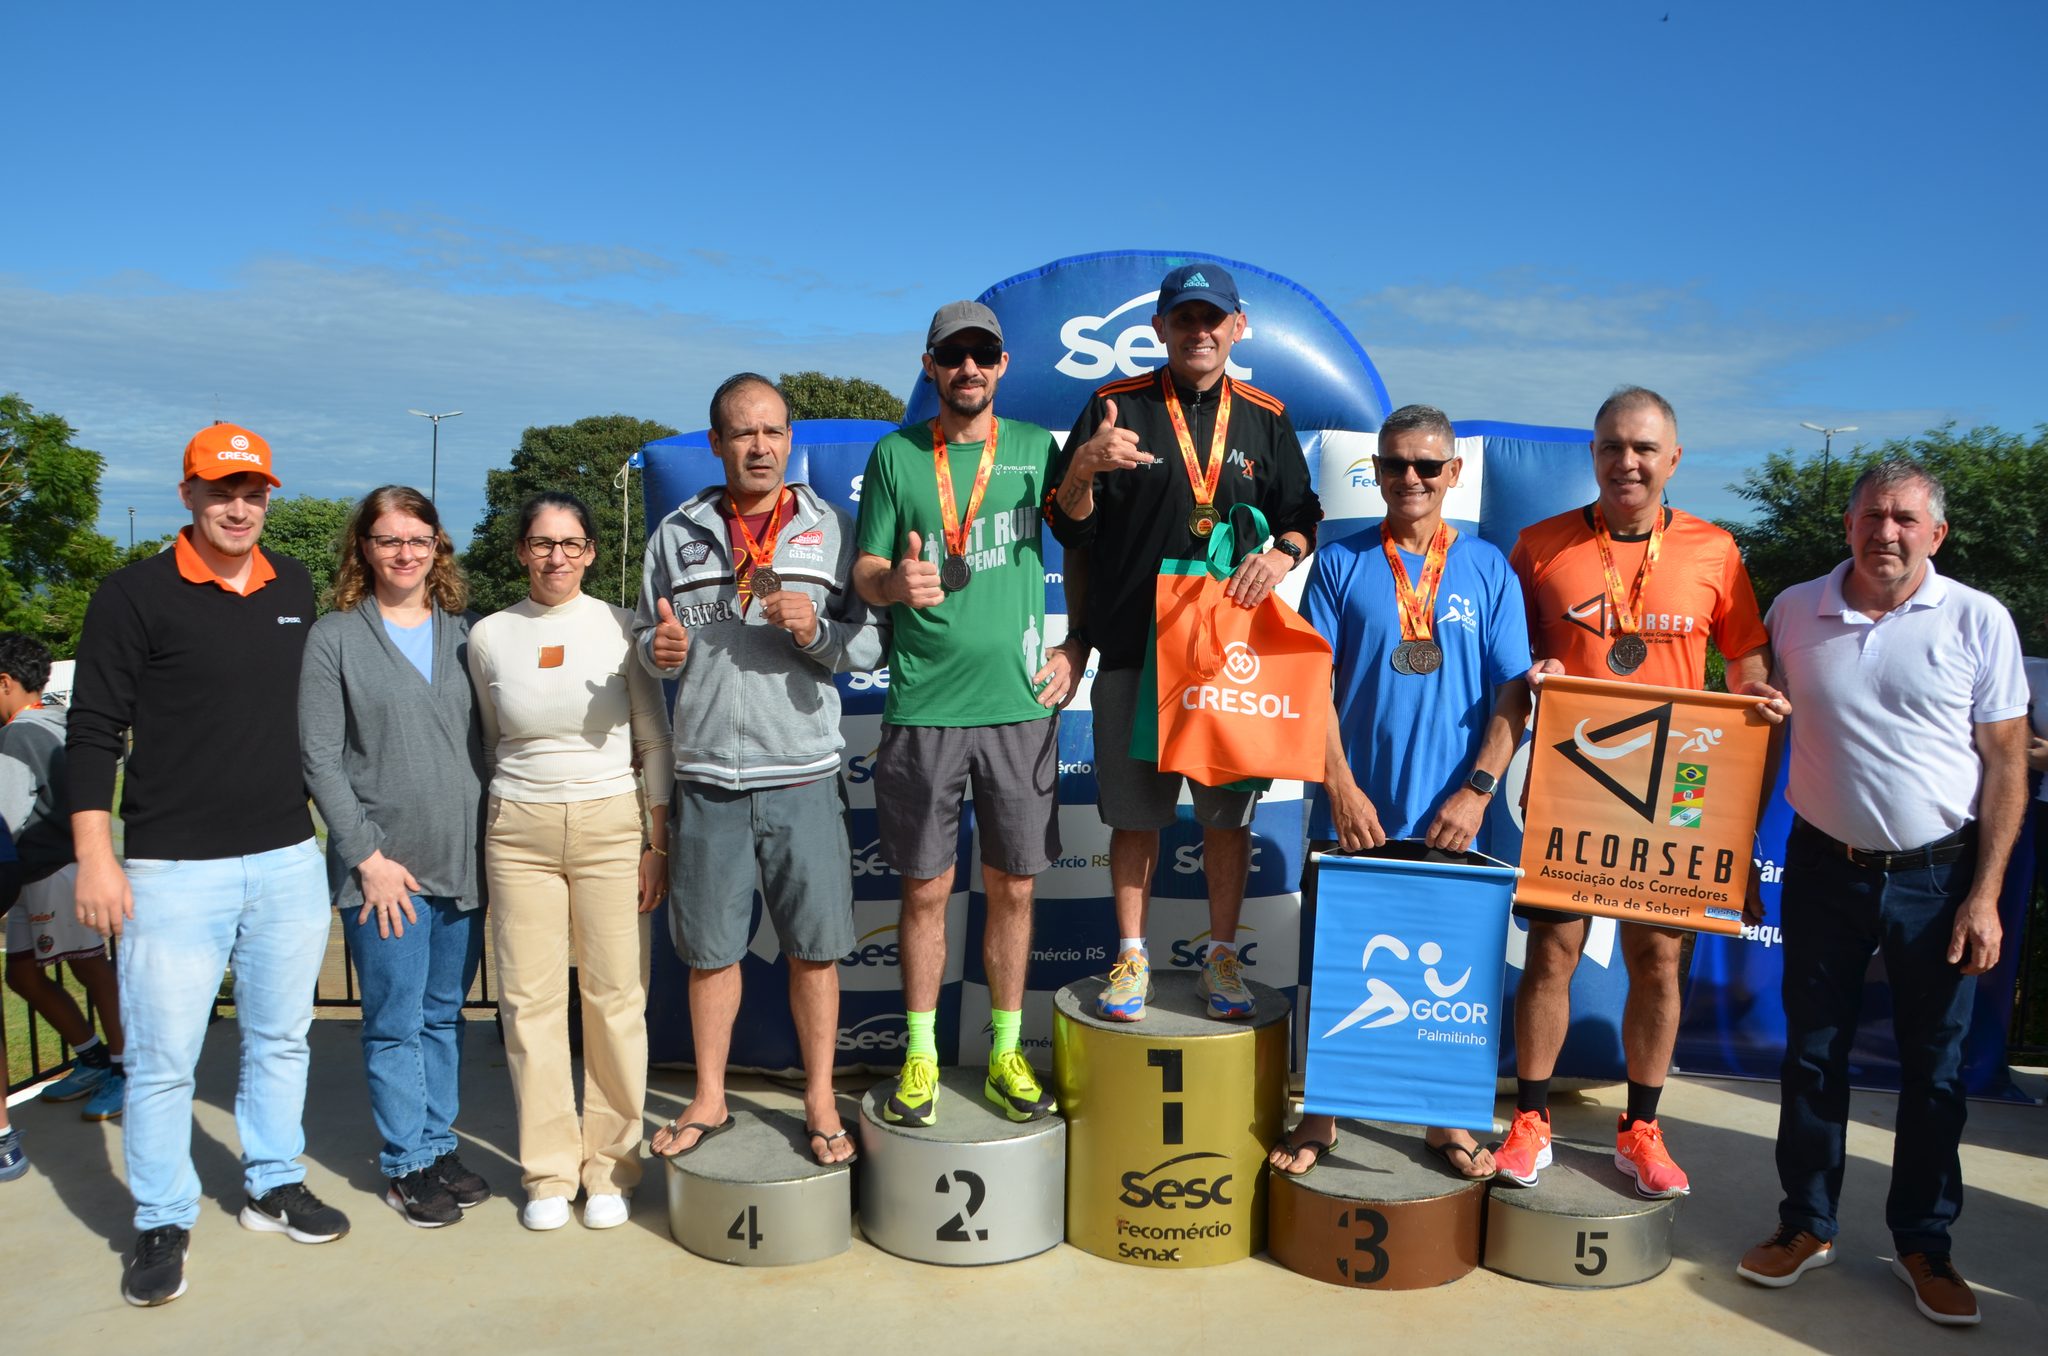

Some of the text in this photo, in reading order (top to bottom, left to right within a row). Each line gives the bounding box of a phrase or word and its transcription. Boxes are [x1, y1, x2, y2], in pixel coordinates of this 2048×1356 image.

[1183, 281, 1210, 289] adidas
[1054, 315, 1253, 380] Sec
[217, 451, 263, 466] CRESOL
[994, 505, 1037, 547] RUN
[965, 545, 1007, 573] PEMA
[1606, 613, 1694, 633] ARSEB
[1182, 685, 1300, 719] CRESOL
[1091, 854, 1111, 868] RS
[1545, 826, 1735, 884] ACORSEB
[1540, 864, 1729, 902] Associação dos Corredores
[1571, 890, 1690, 918] de Rua de Seberi
[1086, 946, 1106, 961] RS
[1412, 998, 1489, 1025] GCOR
[1417, 1028, 1487, 1046] Palmitinho
[1147, 1049, 1184, 1145] 1
[935, 1169, 989, 1242] 2
[1119, 1171, 1233, 1210] Sesc
[727, 1205, 764, 1250] 4
[1117, 1220, 1232, 1241] Fecomércio
[1118, 1243, 1181, 1262] Senac
[1336, 1208, 1390, 1284] 3
[1574, 1231, 1609, 1277] 5
